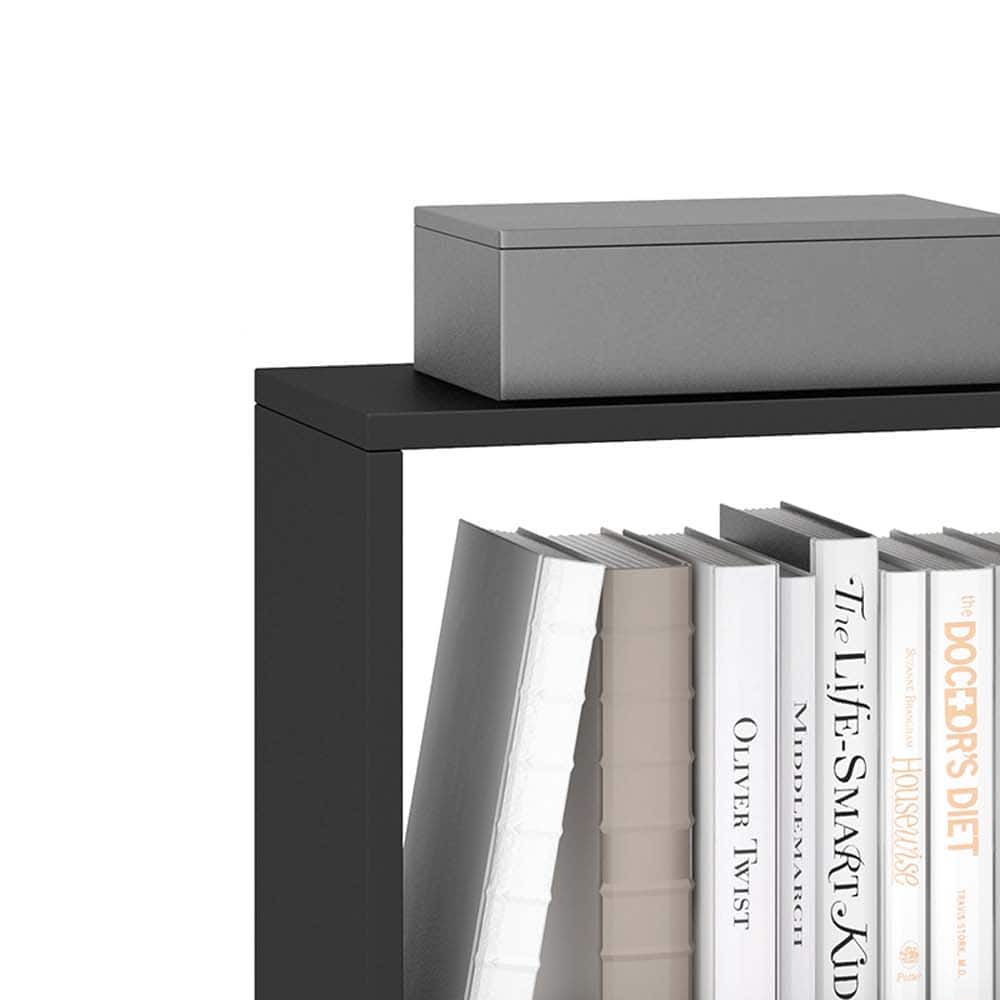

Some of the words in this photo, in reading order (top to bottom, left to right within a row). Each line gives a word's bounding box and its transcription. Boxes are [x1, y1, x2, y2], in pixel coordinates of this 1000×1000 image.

[834, 577, 867, 644] The
[961, 594, 976, 617] the
[733, 717, 758, 828] OLIVER
[793, 703, 808, 946] MIDDLEMARCH
[946, 787, 979, 856] DIET
[733, 838, 758, 931] TWIST
